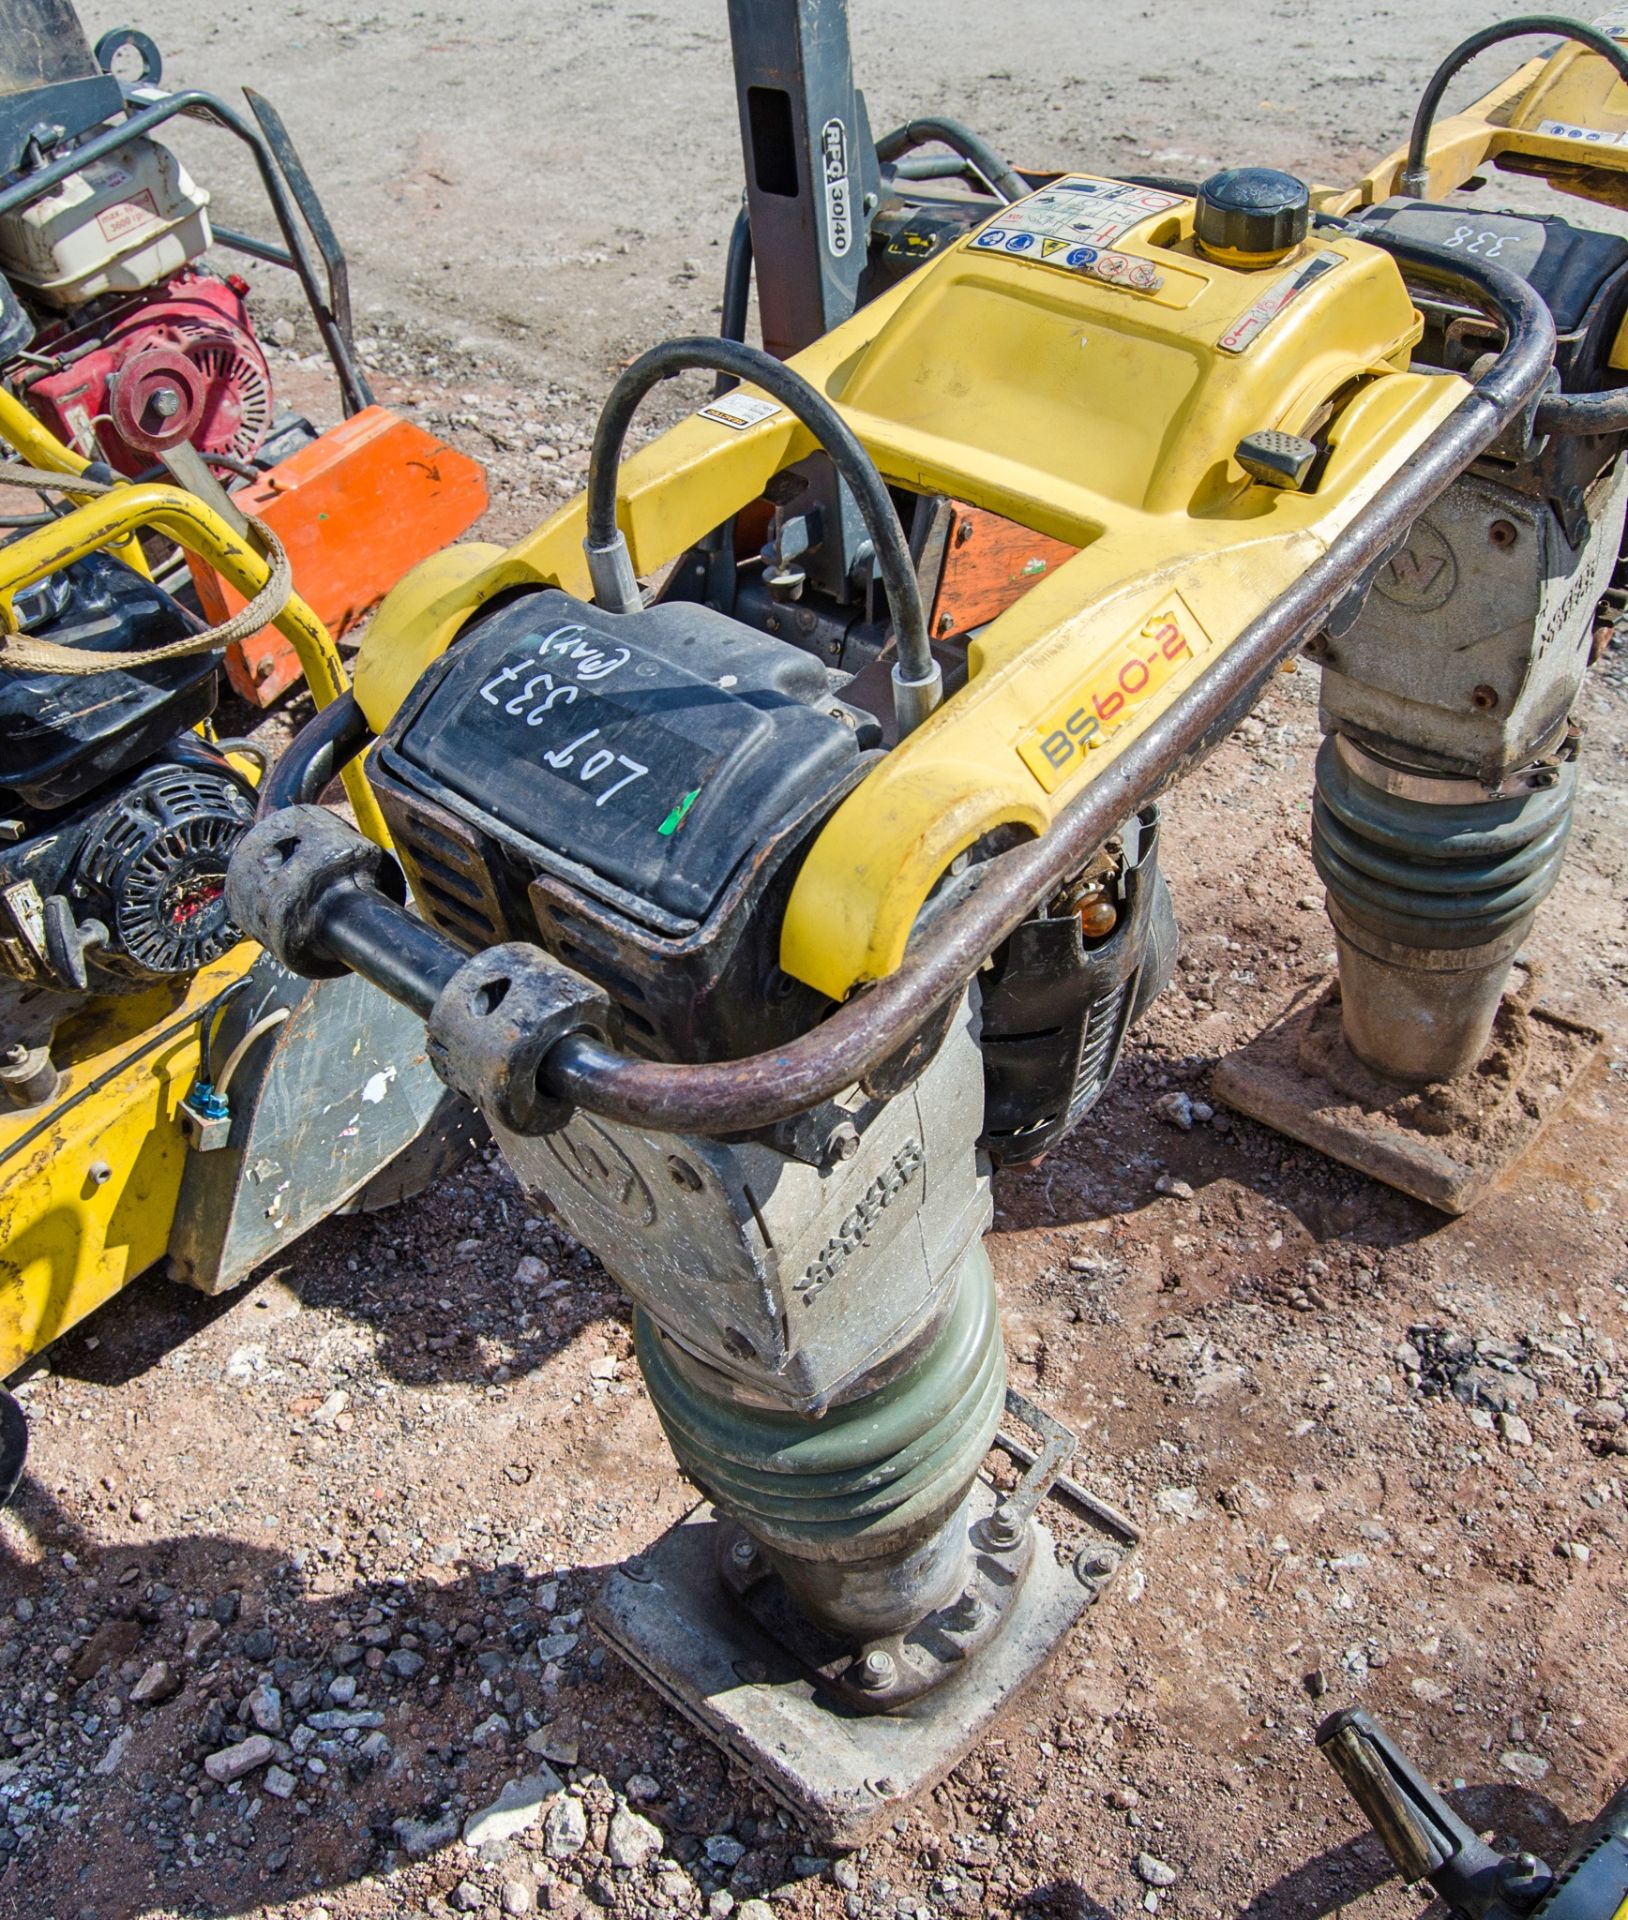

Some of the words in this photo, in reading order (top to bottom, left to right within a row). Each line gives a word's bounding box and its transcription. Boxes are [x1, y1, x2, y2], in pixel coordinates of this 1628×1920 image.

[1443, 226, 1520, 257] 338
[479, 658, 578, 726] 337
[1040, 623, 1187, 769] BS60-2
[543, 728, 648, 806] LOT
